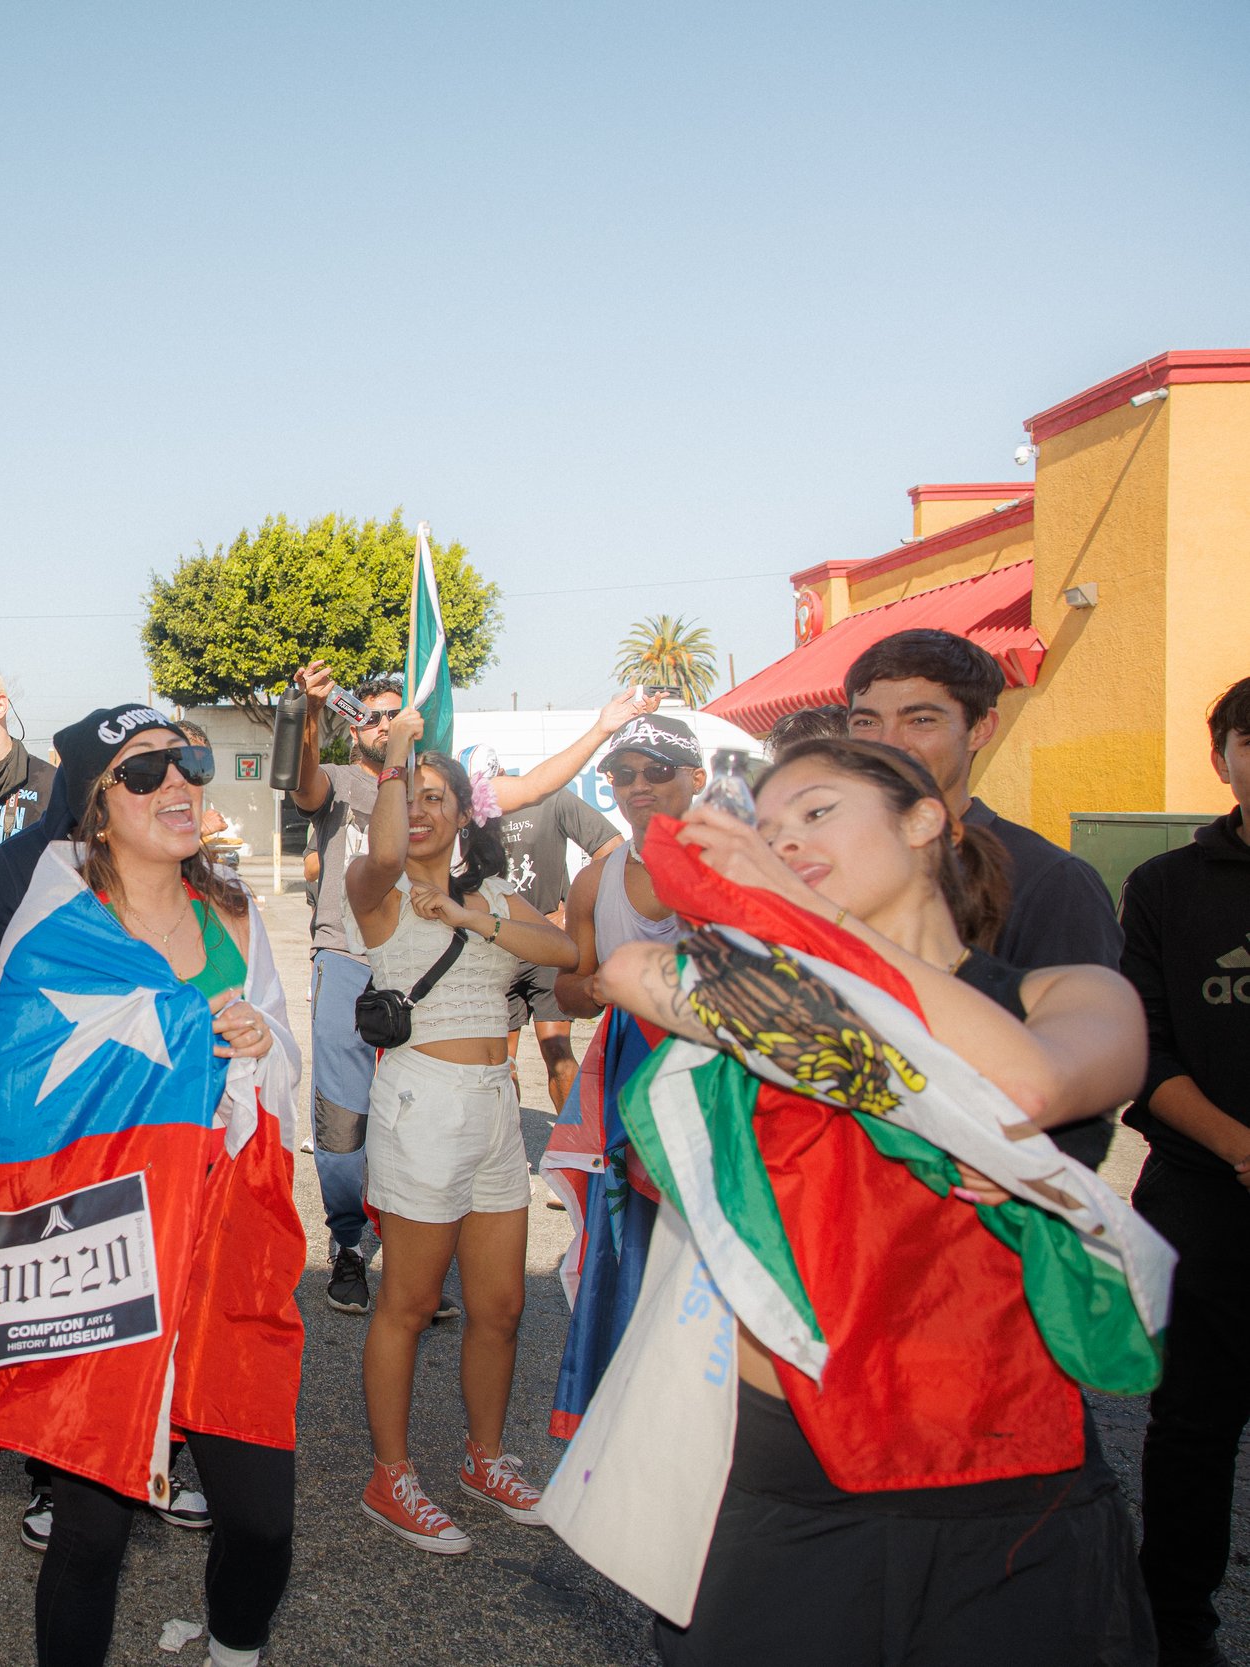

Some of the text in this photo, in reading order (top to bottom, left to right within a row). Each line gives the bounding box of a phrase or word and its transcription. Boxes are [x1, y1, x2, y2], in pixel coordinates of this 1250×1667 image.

[6, 1325, 116, 1352] HISTORY MUSEUM
[7, 1313, 113, 1339] COMPTON ART &
